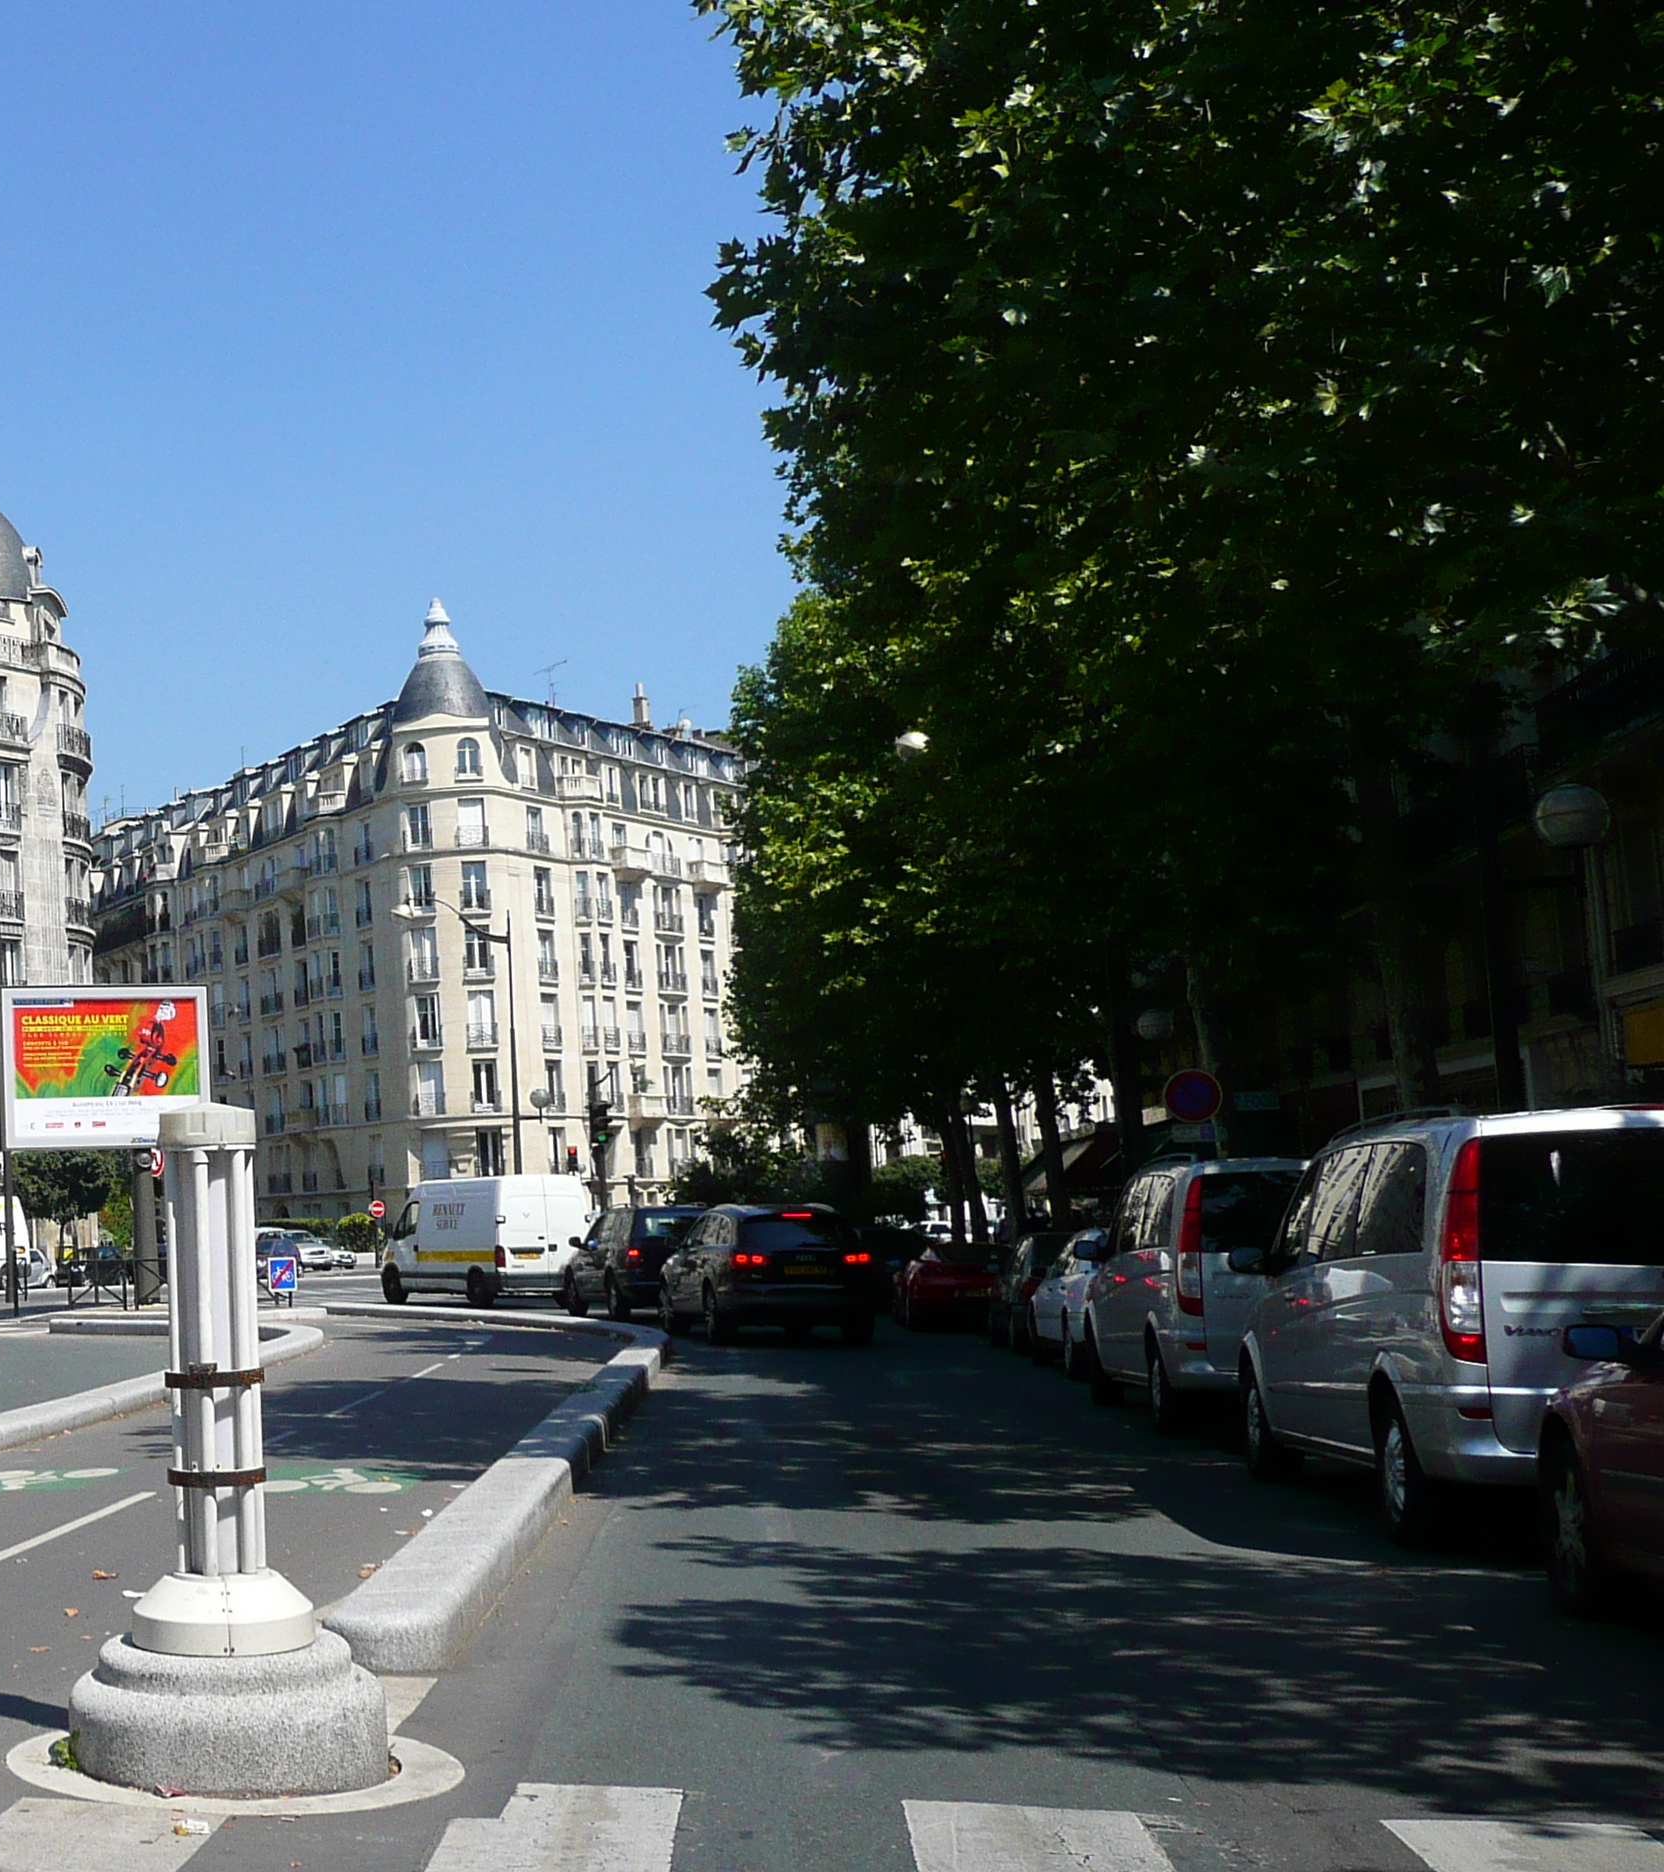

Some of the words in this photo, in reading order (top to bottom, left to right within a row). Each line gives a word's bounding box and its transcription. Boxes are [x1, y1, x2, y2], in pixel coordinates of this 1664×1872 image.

[21, 1015, 81, 1025] CLASSIQUE
[84, 1015, 99, 1024] AU
[101, 1015, 128, 1024] VERT
